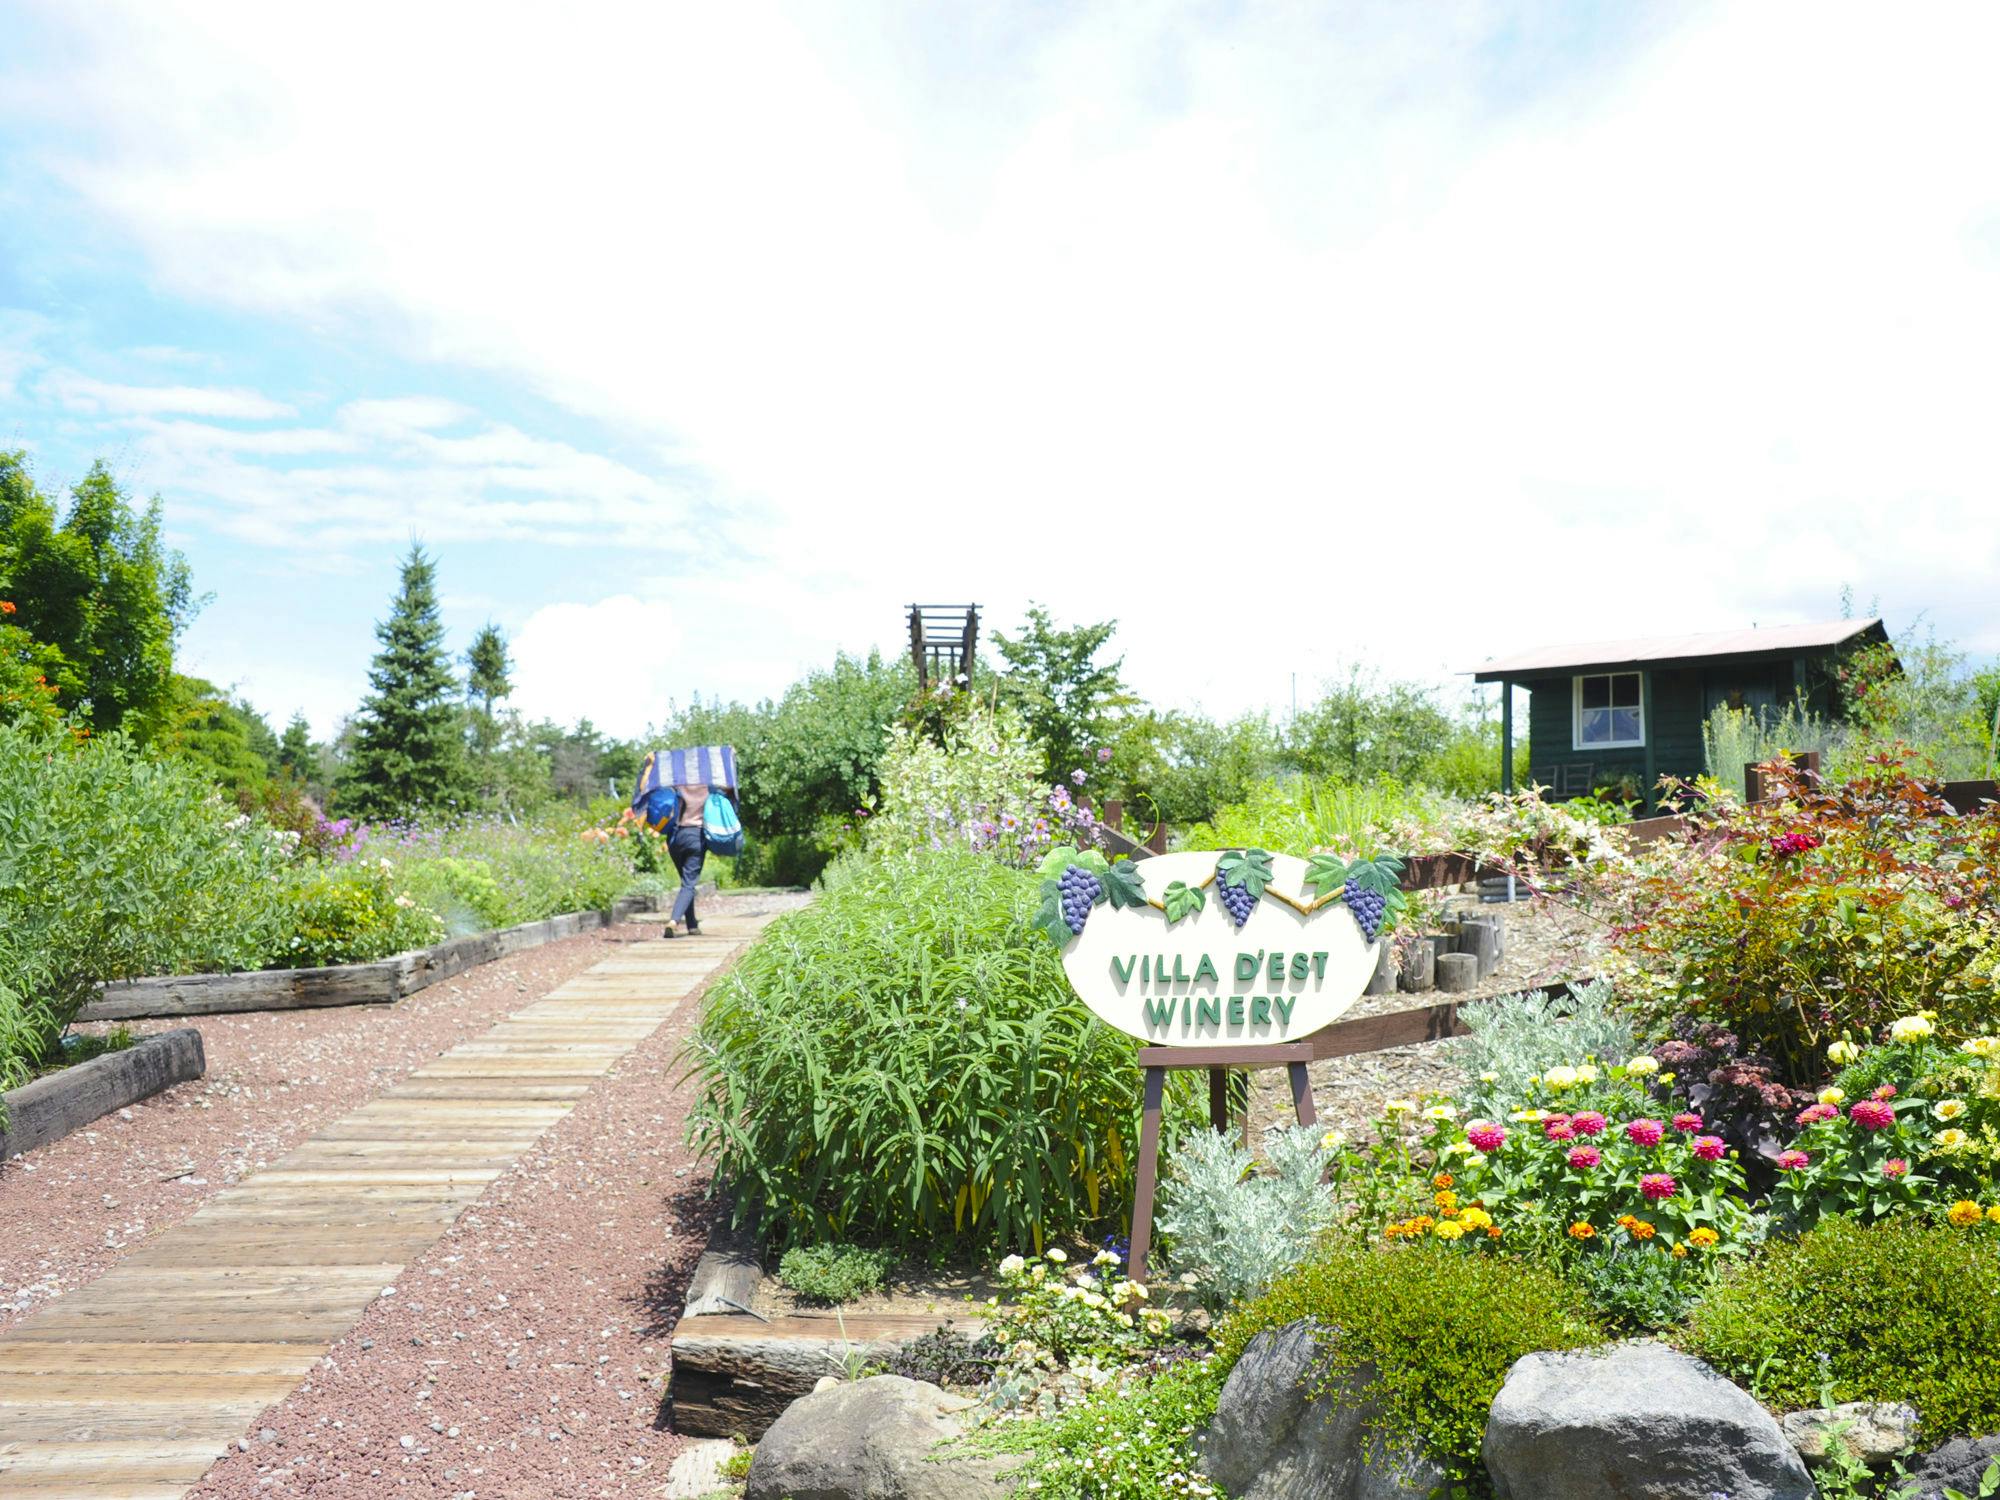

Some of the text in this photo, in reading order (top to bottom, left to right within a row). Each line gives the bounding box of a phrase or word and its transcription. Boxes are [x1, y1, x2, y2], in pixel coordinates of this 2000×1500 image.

[1112, 949, 1329, 983] VILLA D'EST
[1145, 996, 1297, 1026] WINERY
